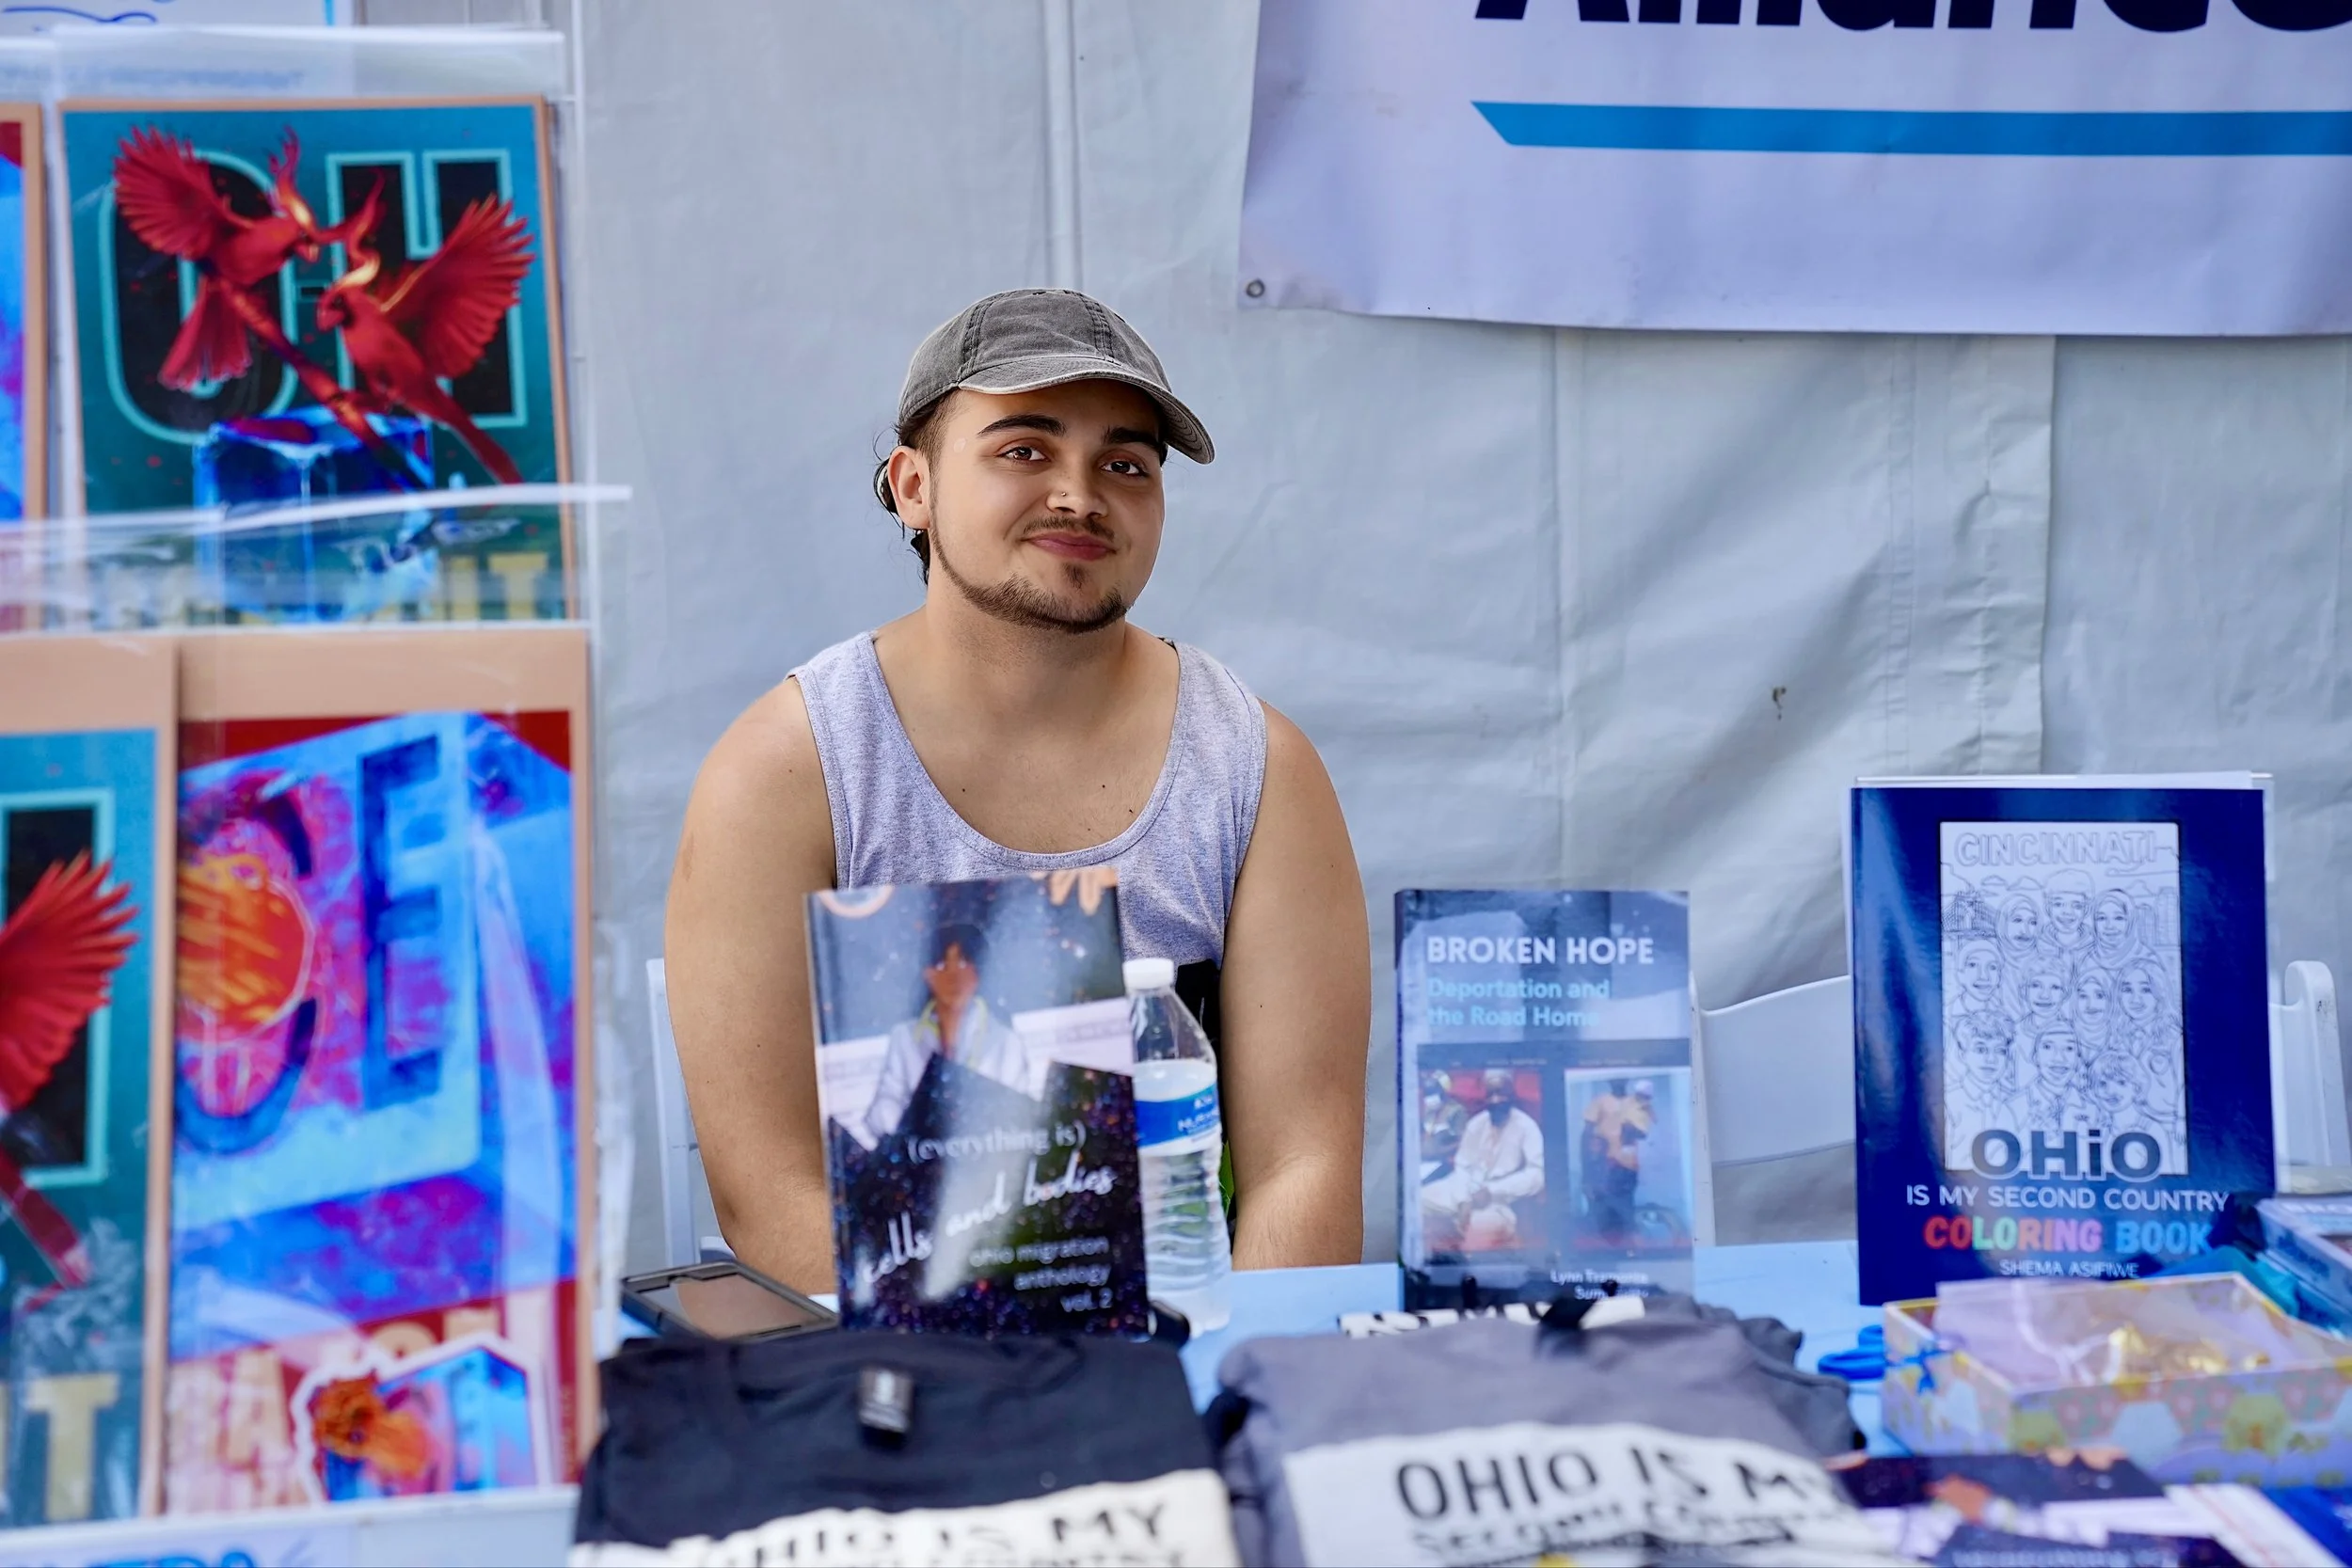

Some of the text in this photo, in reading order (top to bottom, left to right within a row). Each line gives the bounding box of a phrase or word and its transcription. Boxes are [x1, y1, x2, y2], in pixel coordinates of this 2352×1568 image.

[1954, 831, 2157, 867] CINCINNATI
[1426, 936, 1655, 965] BROKEN HOPE
[1426, 977, 1611, 1002] Deportation and
[1426, 1006, 1464, 1026] the
[1470, 1006, 1526, 1026] Road
[946, 1172, 1012, 1237] and
[1907, 1185, 2229, 1212] IS MY SECOND COUNTRY
[1924, 1215, 2213, 1254] COLORING BOOK
[1549, 1269, 1583, 1286] Lynn
[1999, 1259, 2064, 1277] SHEMA
[1396, 1449, 1599, 1521] OHIO
